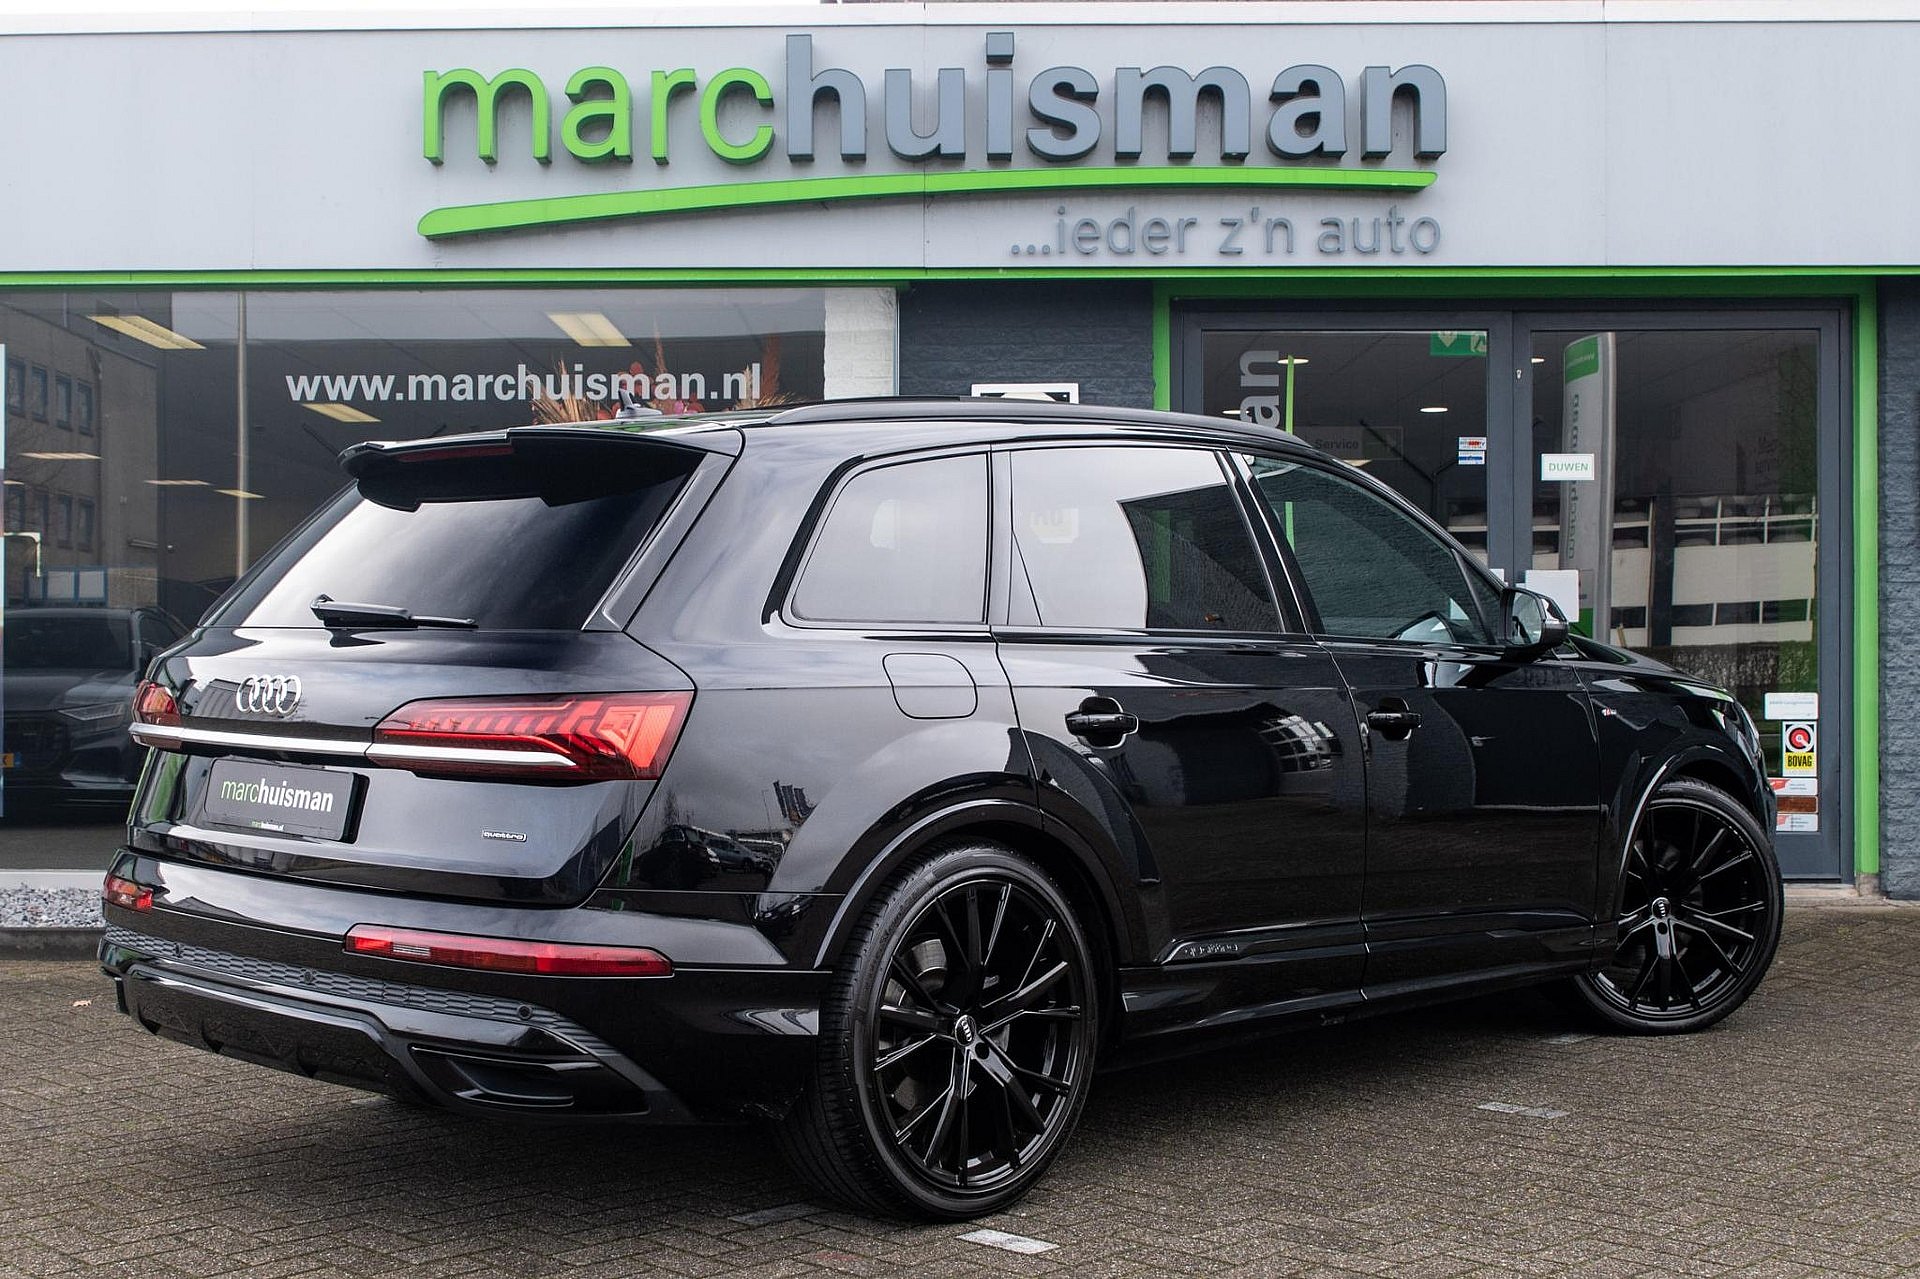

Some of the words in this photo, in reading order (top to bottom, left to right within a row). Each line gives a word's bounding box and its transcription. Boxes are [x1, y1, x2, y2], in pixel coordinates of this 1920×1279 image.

[423, 33, 1447, 166] marchuisman
[1219, 206, 1295, 256] z'n
[1317, 205, 1442, 256] auto
[285, 363, 761, 402] www.marchuisman.nl
[1314, 438, 1359, 450] Service
[1548, 462, 1589, 472] DUWEN
[1787, 755, 1813, 767] BOVAG
[220, 778, 334, 813] marchuisman
